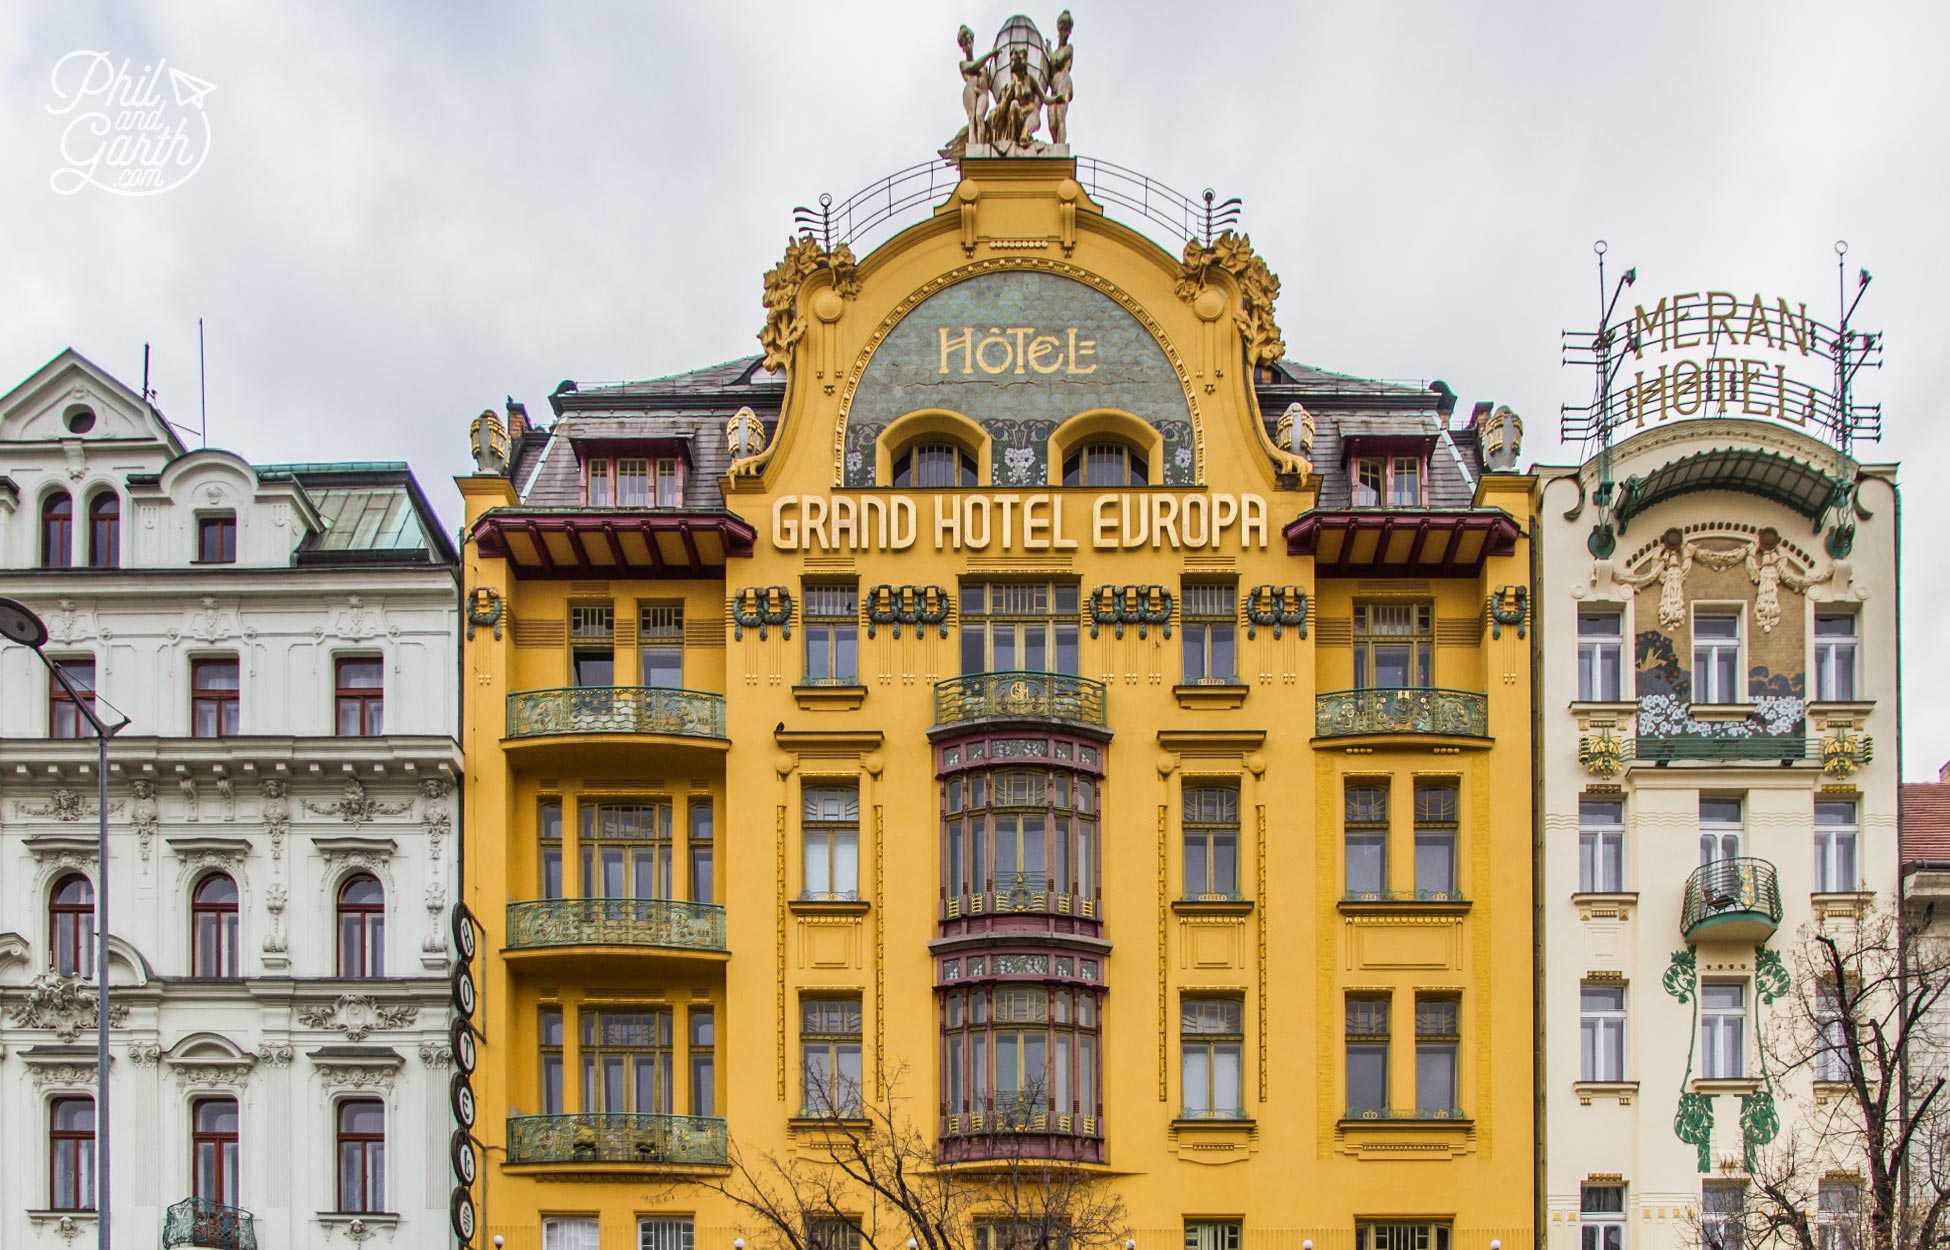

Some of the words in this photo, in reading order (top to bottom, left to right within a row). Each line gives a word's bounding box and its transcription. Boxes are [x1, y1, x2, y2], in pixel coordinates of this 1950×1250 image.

[1634, 292, 1809, 360] MERAN
[1634, 358, 1806, 428] HOTEL
[772, 494, 917, 549] GRAND
[934, 494, 1079, 549] HOTEL
[1093, 493, 1268, 548] EUROPA
